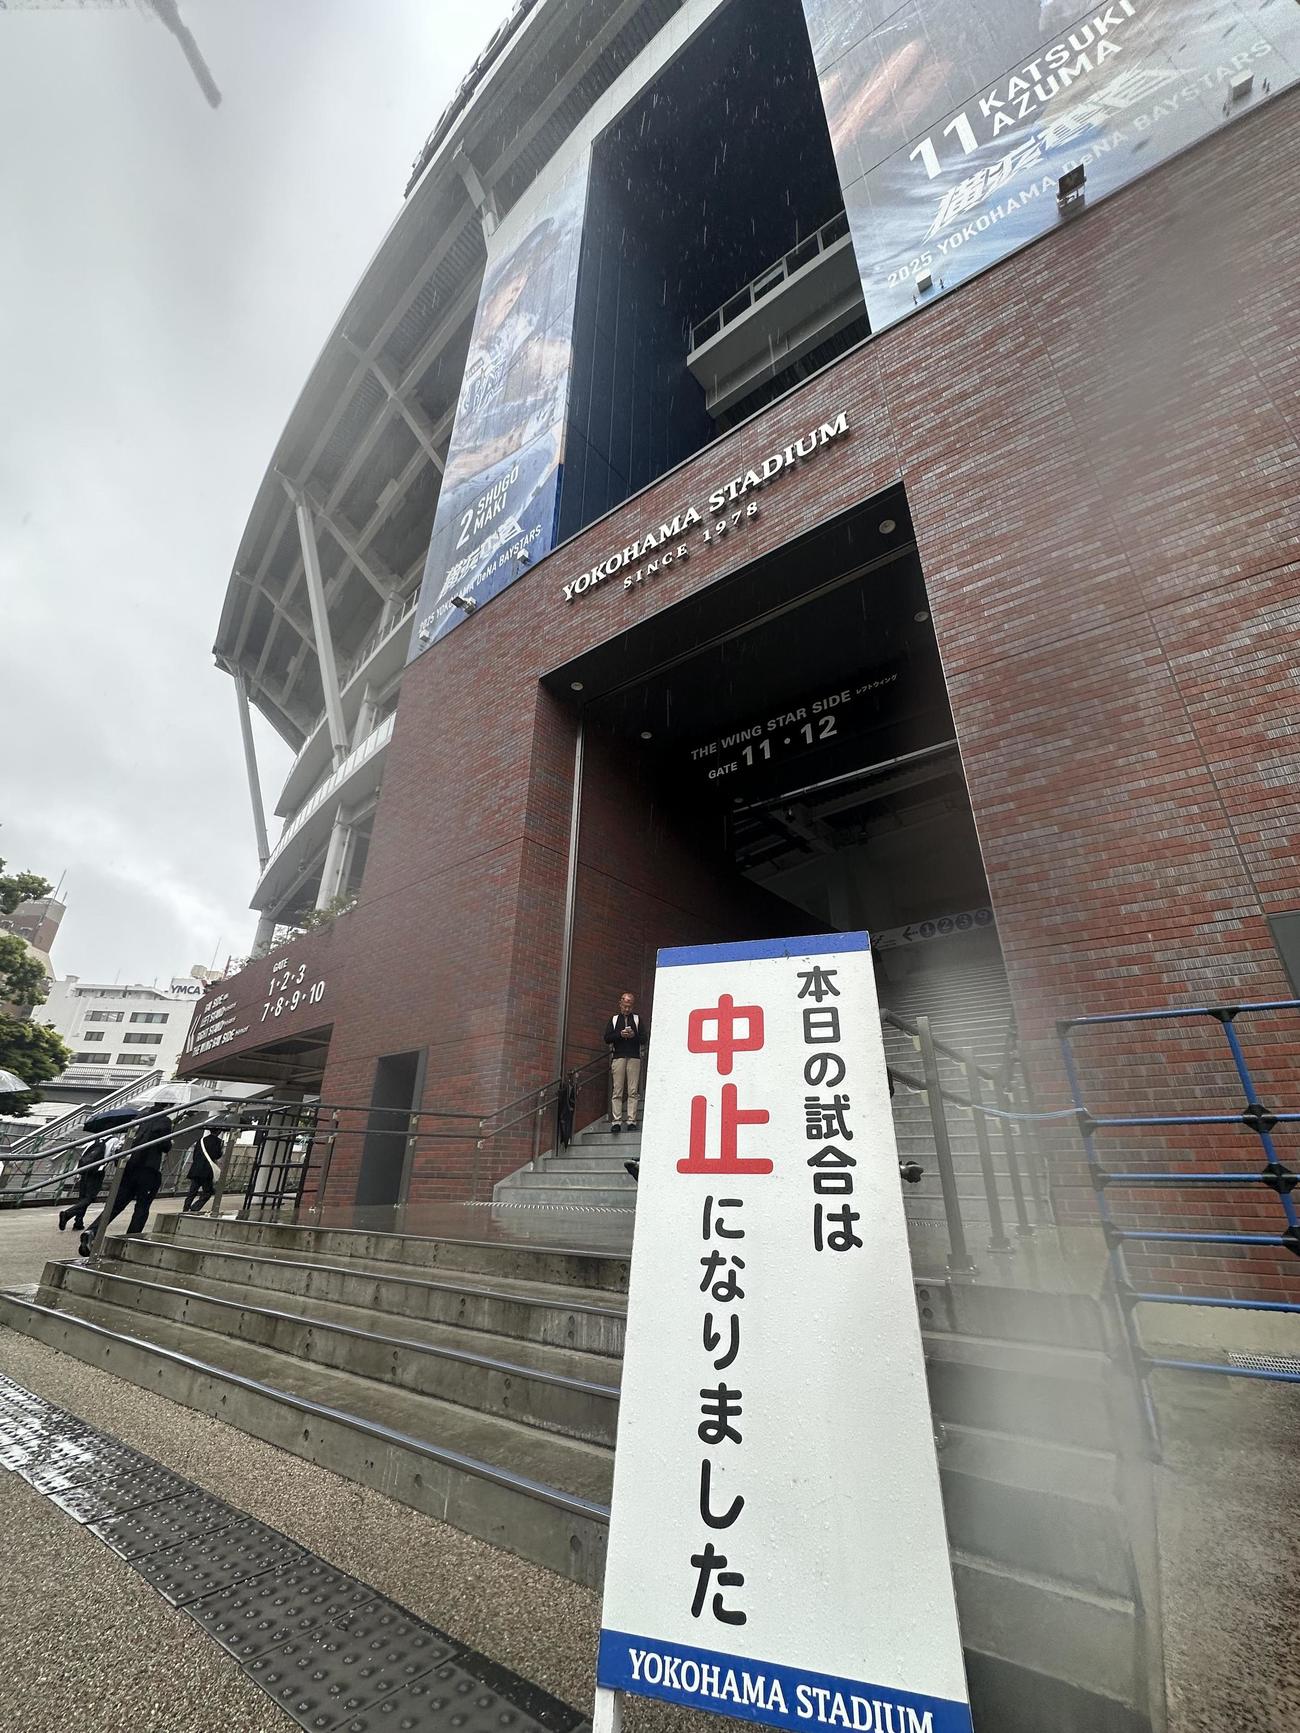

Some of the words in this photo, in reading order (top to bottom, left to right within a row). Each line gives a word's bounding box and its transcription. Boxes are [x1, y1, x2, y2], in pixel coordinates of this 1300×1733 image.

[978, 0, 1136, 119] KATSUKI
[991, 39, 1123, 137] AZUMA
[887, 250, 933, 289] 2025
[936, 175, 1058, 255] YOKOHAMA
[1133, 39, 1272, 132] BAYSTARS
[909, 111, 979, 181] 11
[473, 491, 508, 537] MAKI
[477, 465, 519, 515] SHUGO
[562, 507, 702, 602] YOKOHAMA
[708, 410, 850, 513] STADIUM
[456, 509, 475, 550] 2
[499, 524, 542, 567] BAYSTARS
[623, 543, 688, 590] SINCE
[702, 501, 759, 544] 1978
[691, 742, 717, 760] THE
[721, 725, 762, 748] WING
[766, 708, 807, 731] STAR
[812, 690, 851, 714] SIDE
[708, 761, 738, 779] GATE
[171, 984, 200, 995] YMCA
[272, 957, 289, 973] GATE
[797, 965, 863, 1253] 本日の試合は
[628, 1647, 789, 1715] YOKOHAMA
[796, 1684, 934, 1733] STADIUM
